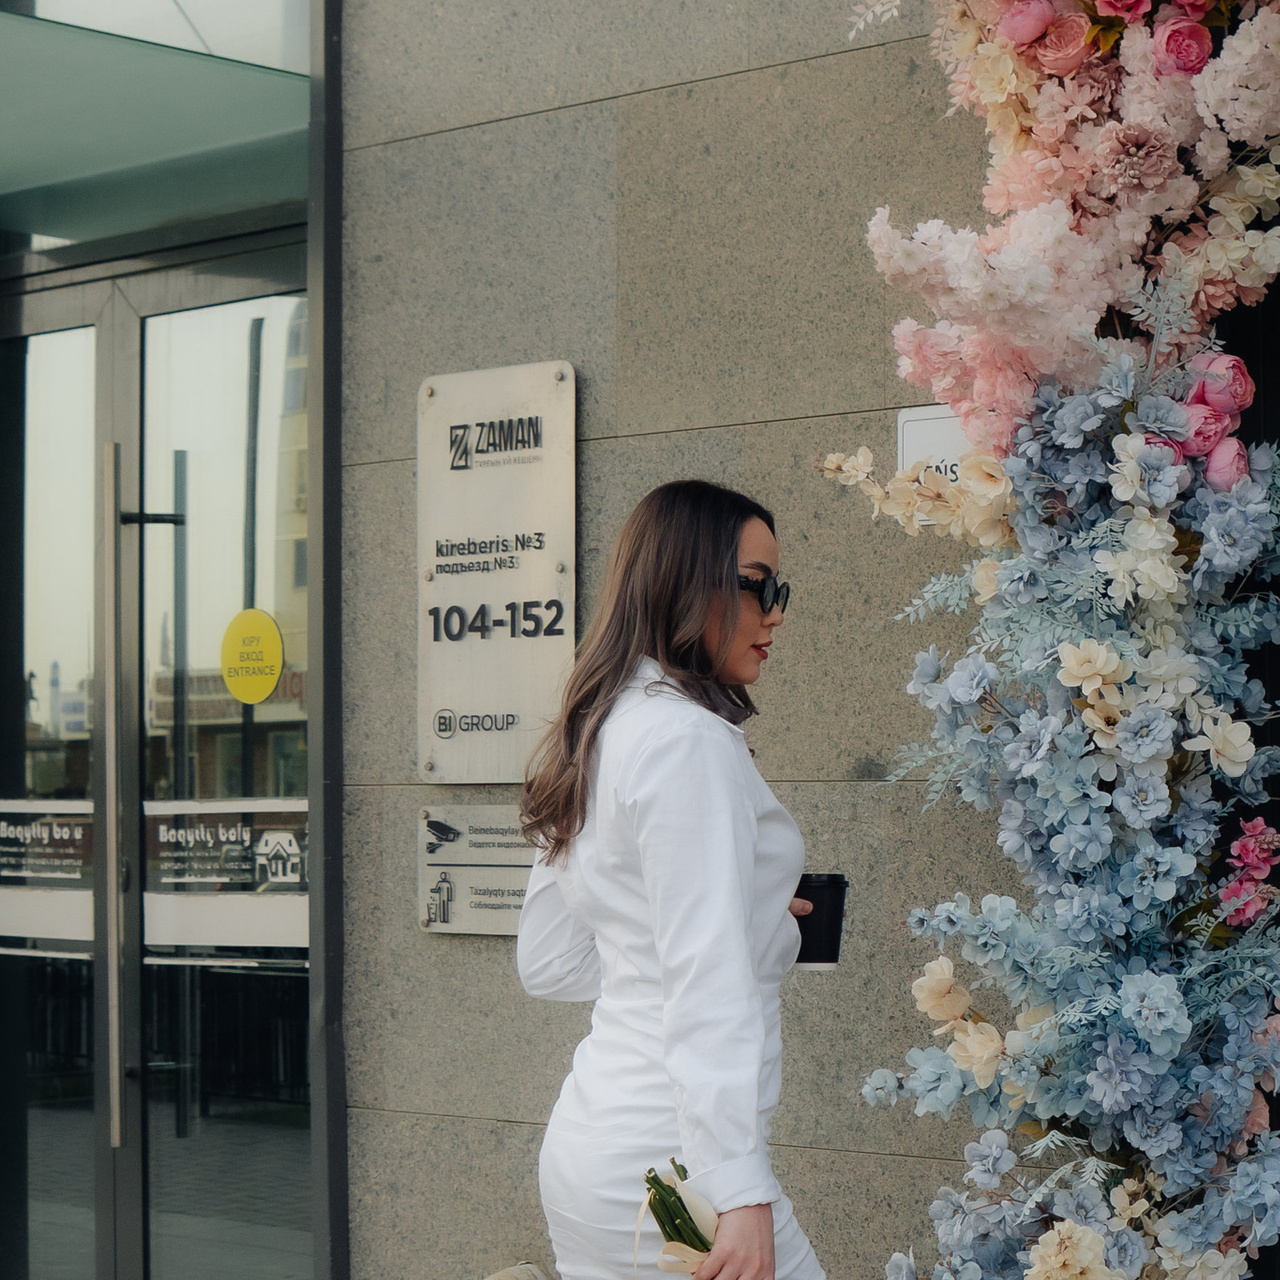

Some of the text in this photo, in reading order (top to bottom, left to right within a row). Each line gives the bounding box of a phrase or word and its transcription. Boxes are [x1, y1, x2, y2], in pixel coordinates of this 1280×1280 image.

[475, 416, 541, 453] ZAMAN
[436, 535, 509, 557] kireberis
[436, 559, 490, 574] подъезд
[428, 599, 564, 642] 104-152
[239, 651, 264, 663] ВХОД
[227, 665, 276, 678] ENTRANCE
[438, 714, 517, 732] BI GROUP
